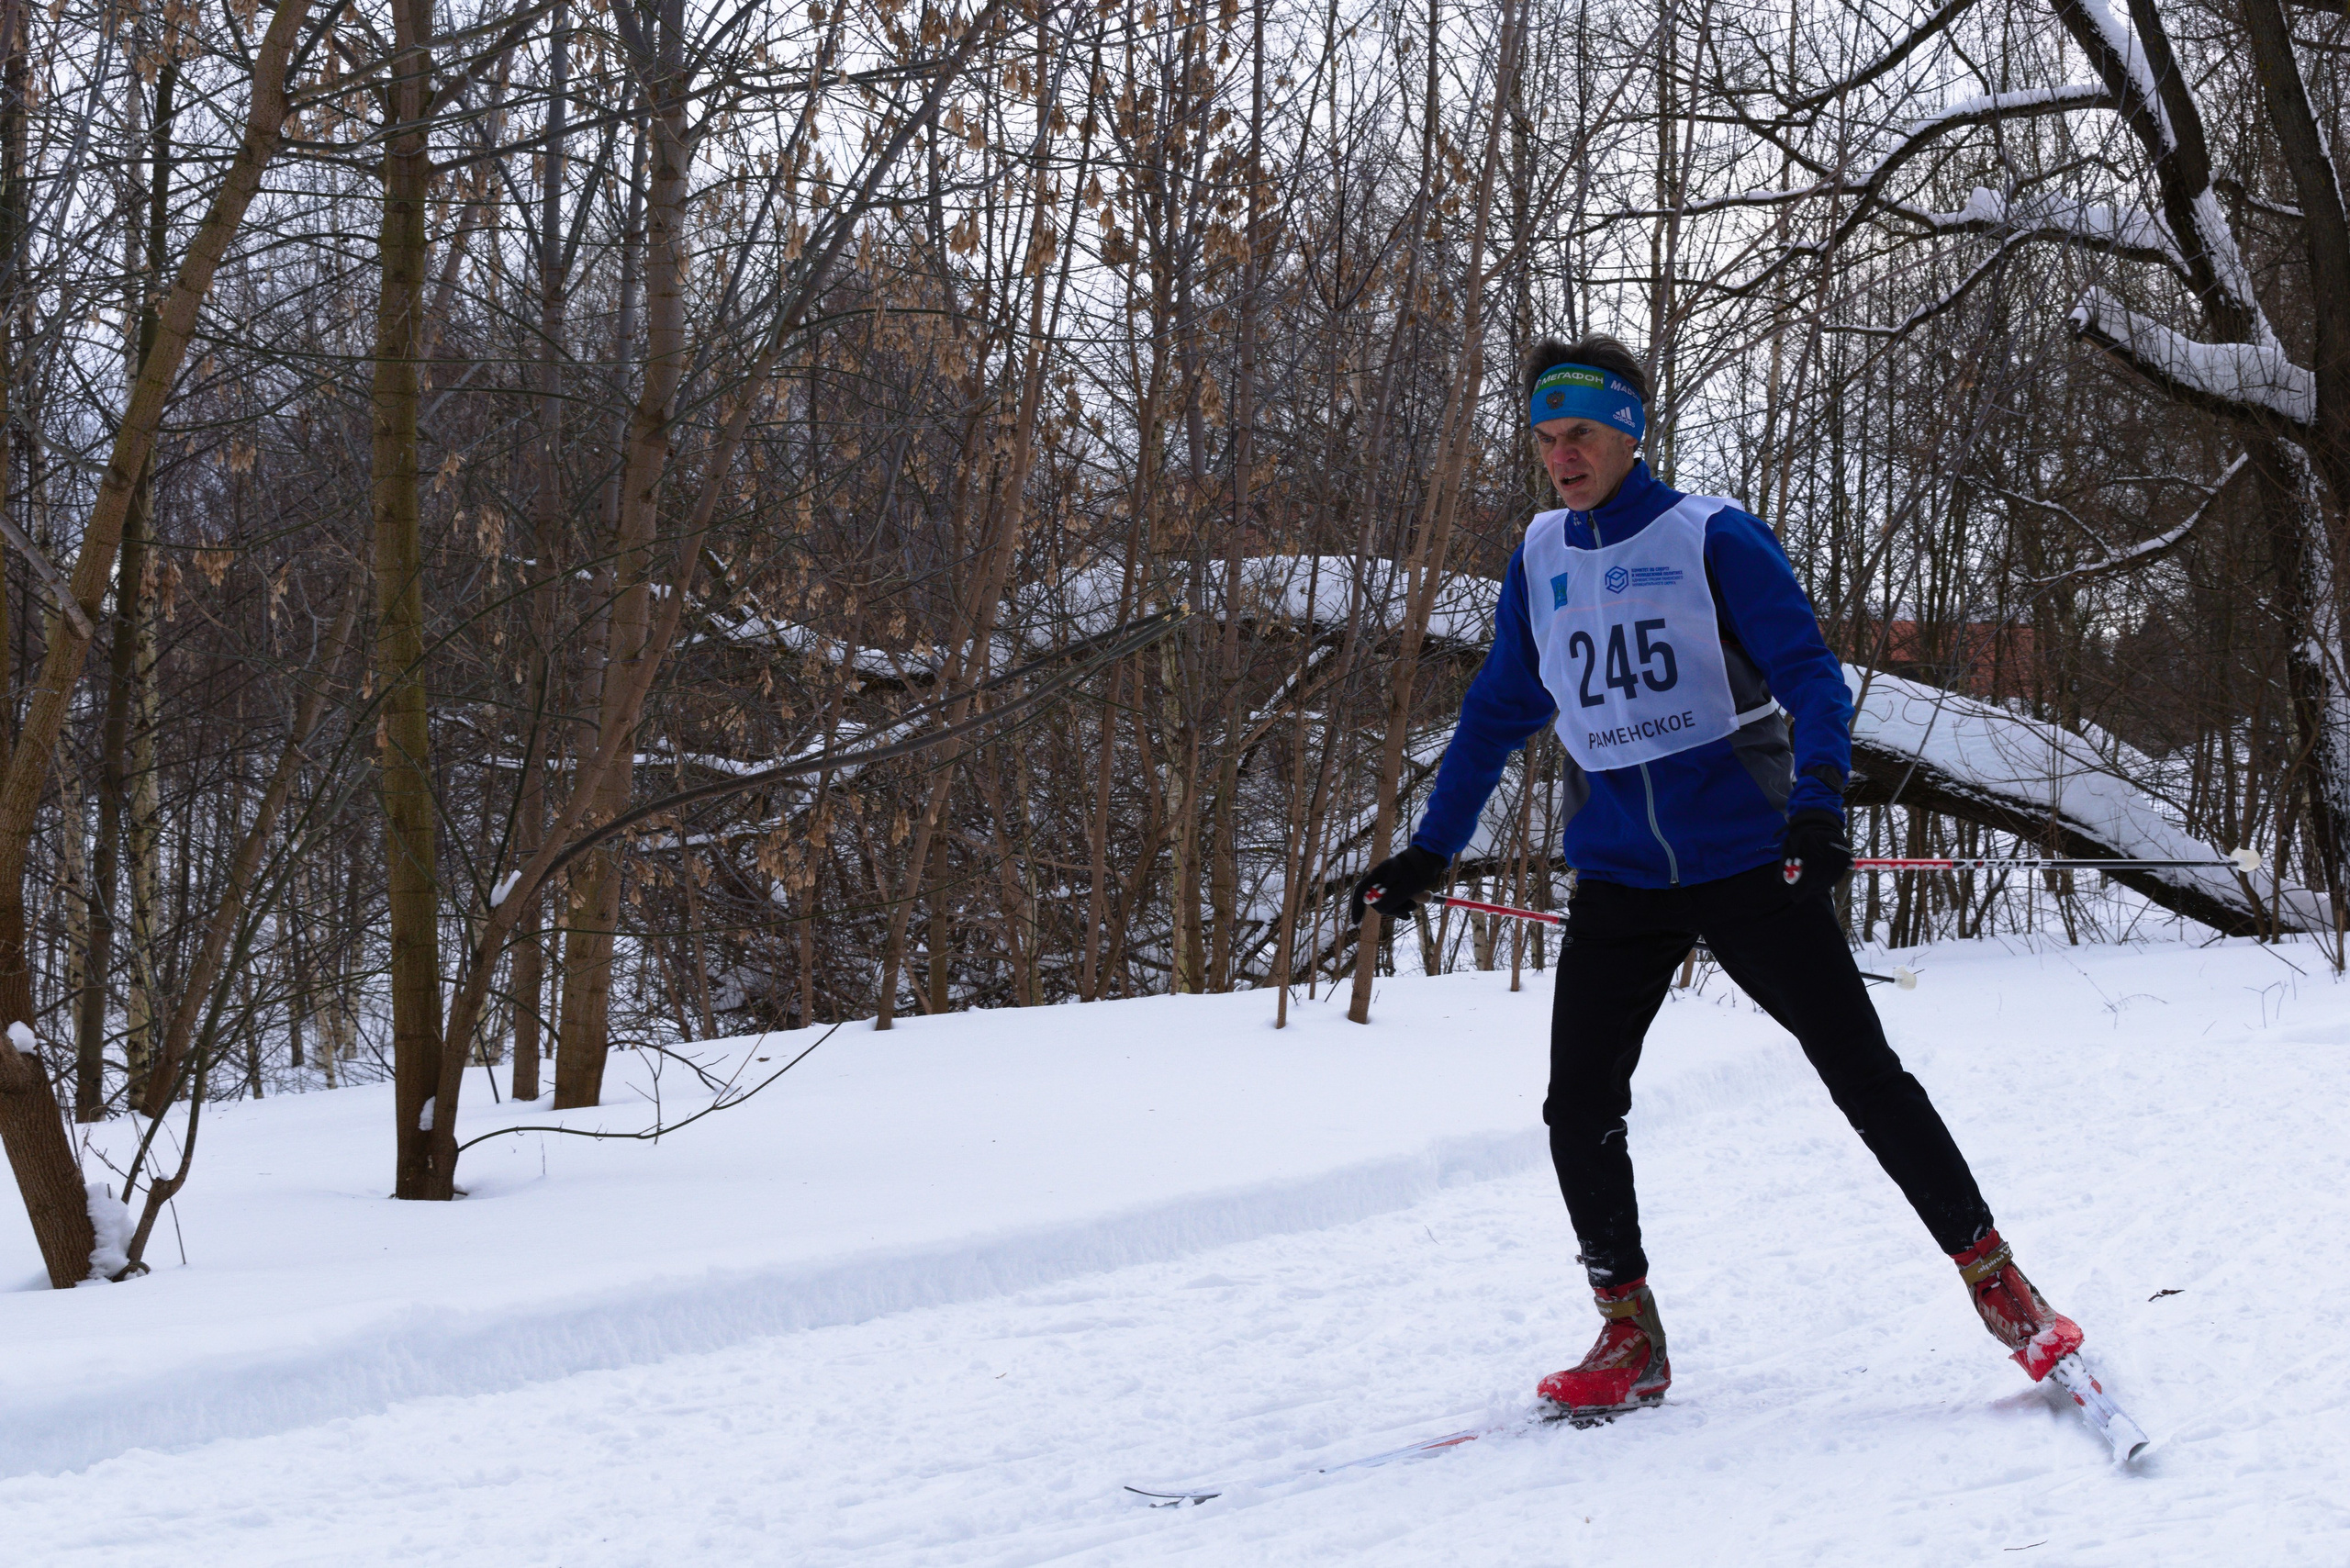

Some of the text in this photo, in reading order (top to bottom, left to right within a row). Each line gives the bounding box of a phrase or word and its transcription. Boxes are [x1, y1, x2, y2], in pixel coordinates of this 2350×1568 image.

[1541, 372, 1604, 385] МЕГАФОН
[1612, 413, 1636, 429] adidas
[1569, 618, 1678, 709] 245
[1588, 711, 1695, 750] РАМЕНСКОЕ
[1977, 1254, 2005, 1273] alpina
